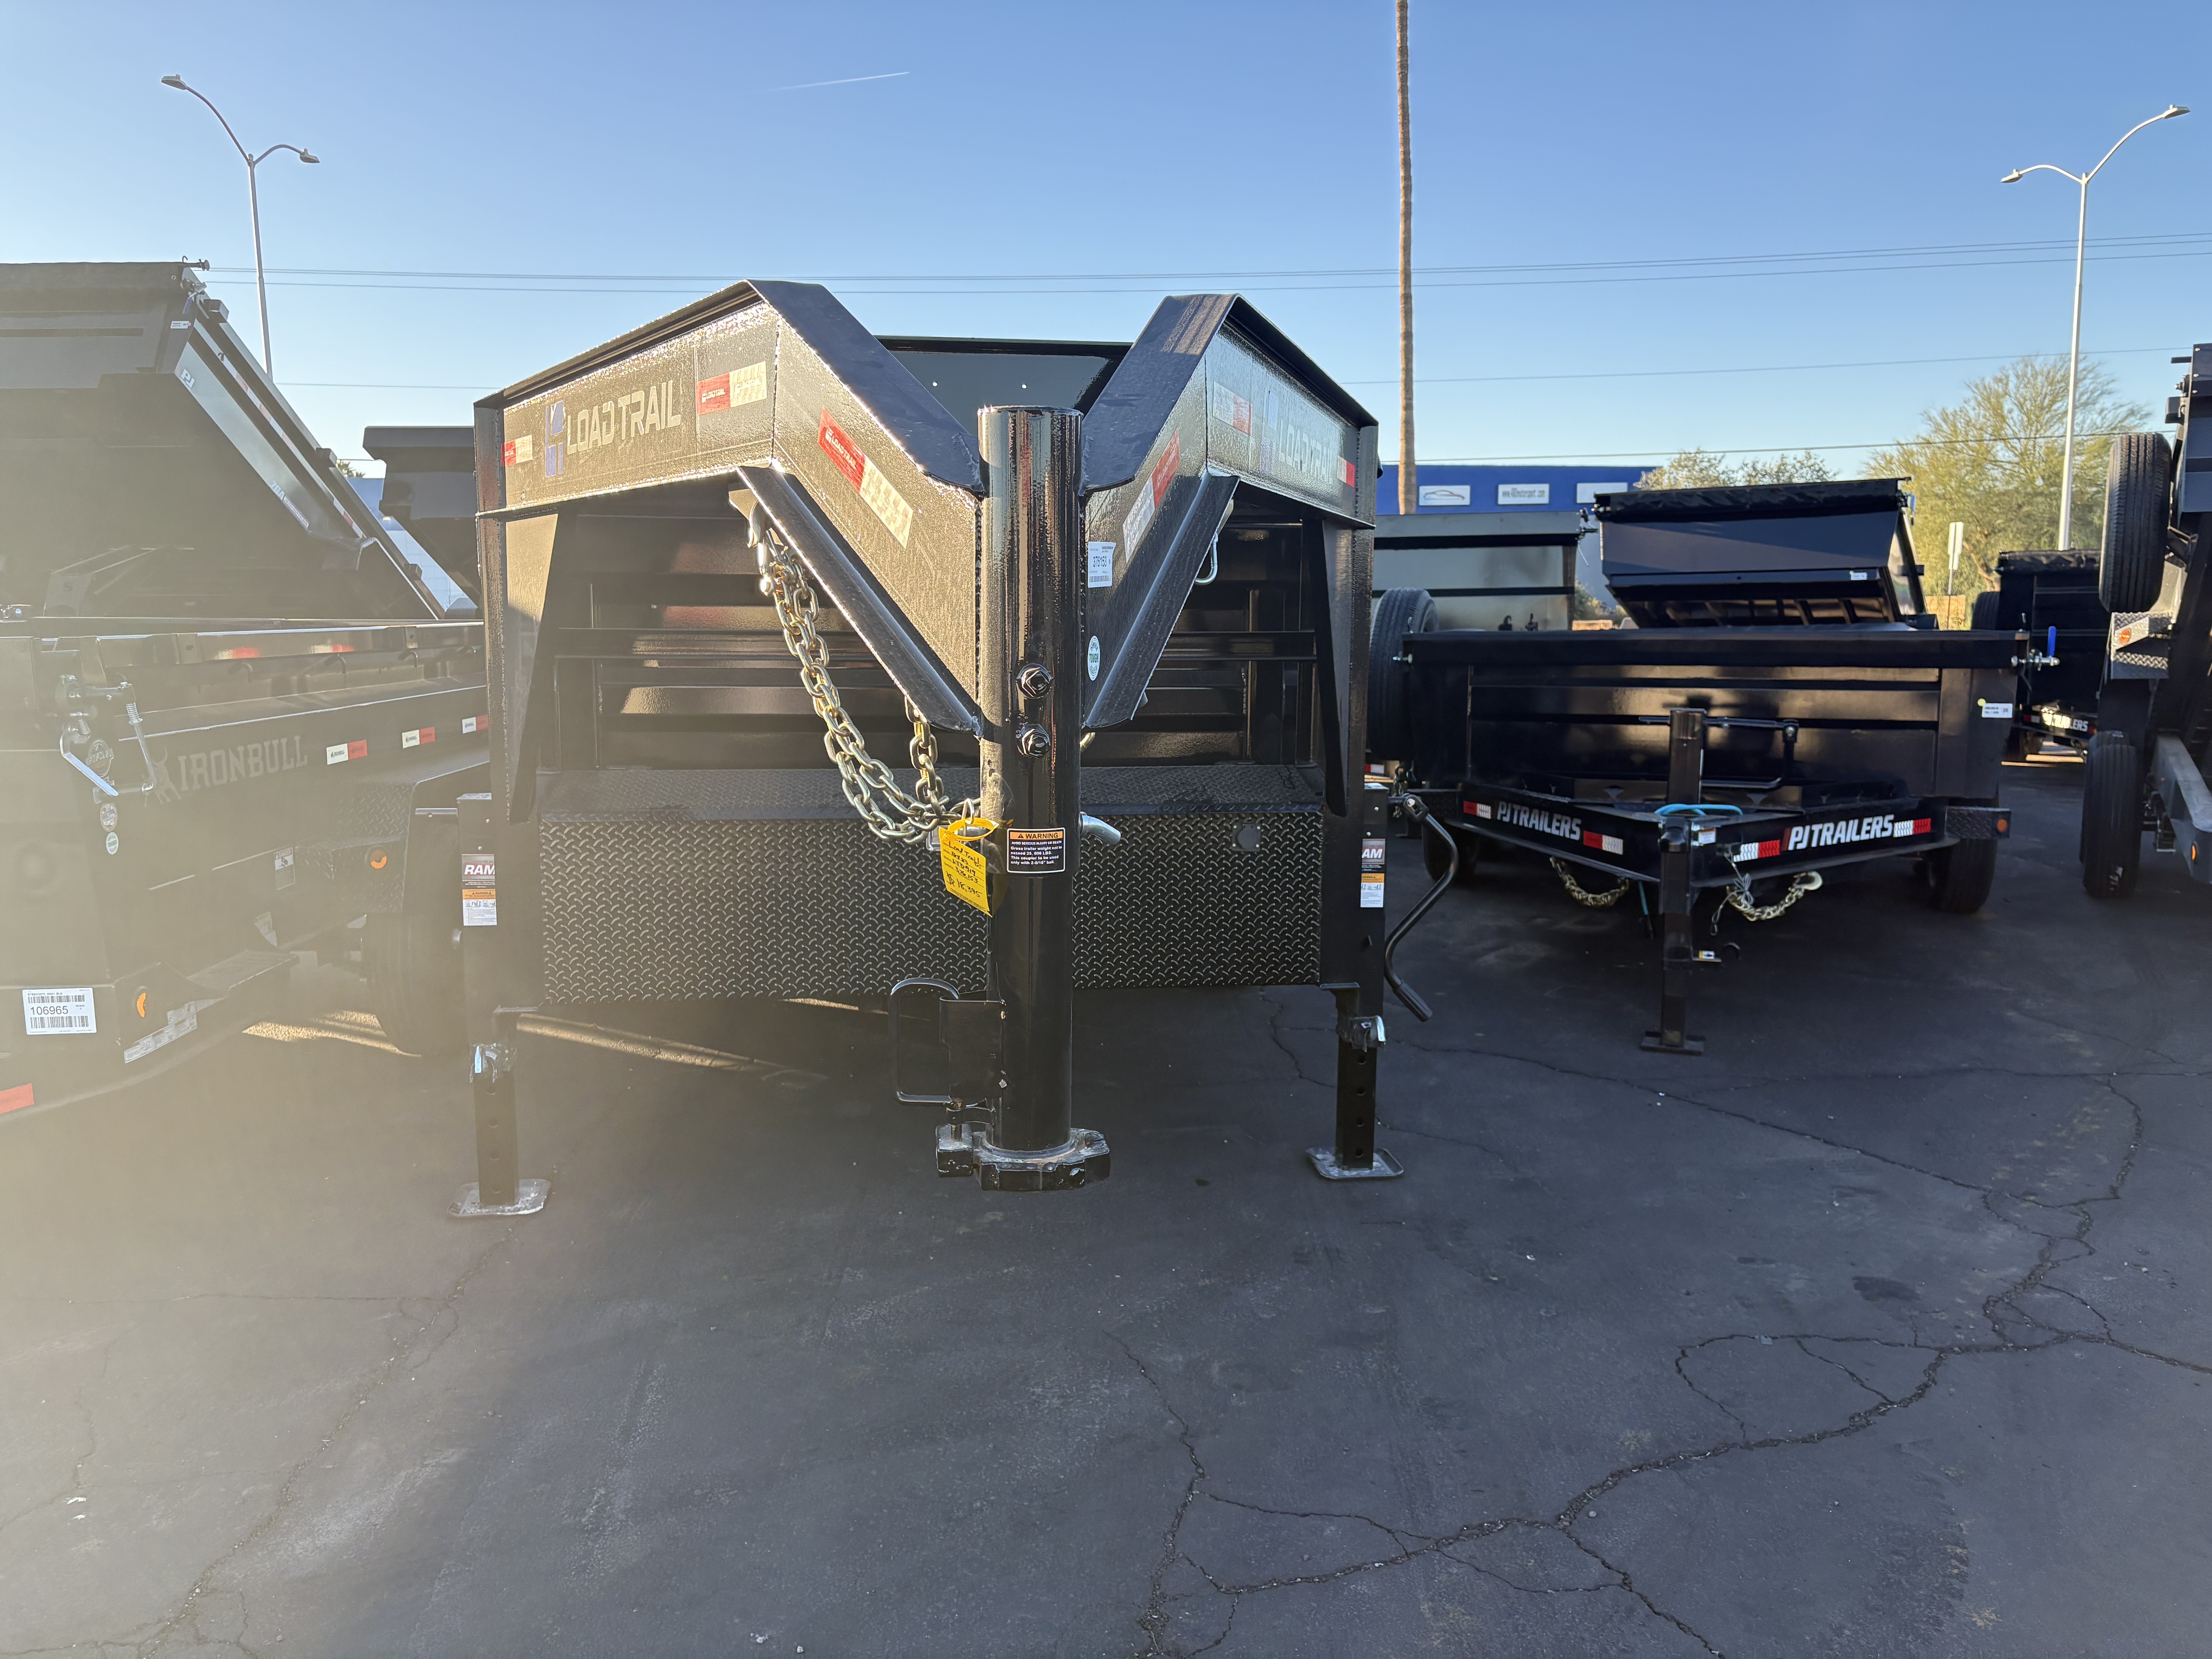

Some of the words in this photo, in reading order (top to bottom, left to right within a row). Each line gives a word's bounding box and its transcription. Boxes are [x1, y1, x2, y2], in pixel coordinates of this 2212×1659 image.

[181, 369, 195, 388] PJ
[1093, 556, 1107, 567] 376153
[178, 735, 307, 791] IRONBULL
[464, 860, 495, 875] RAM
[30, 1005, 69, 1015] 106965
